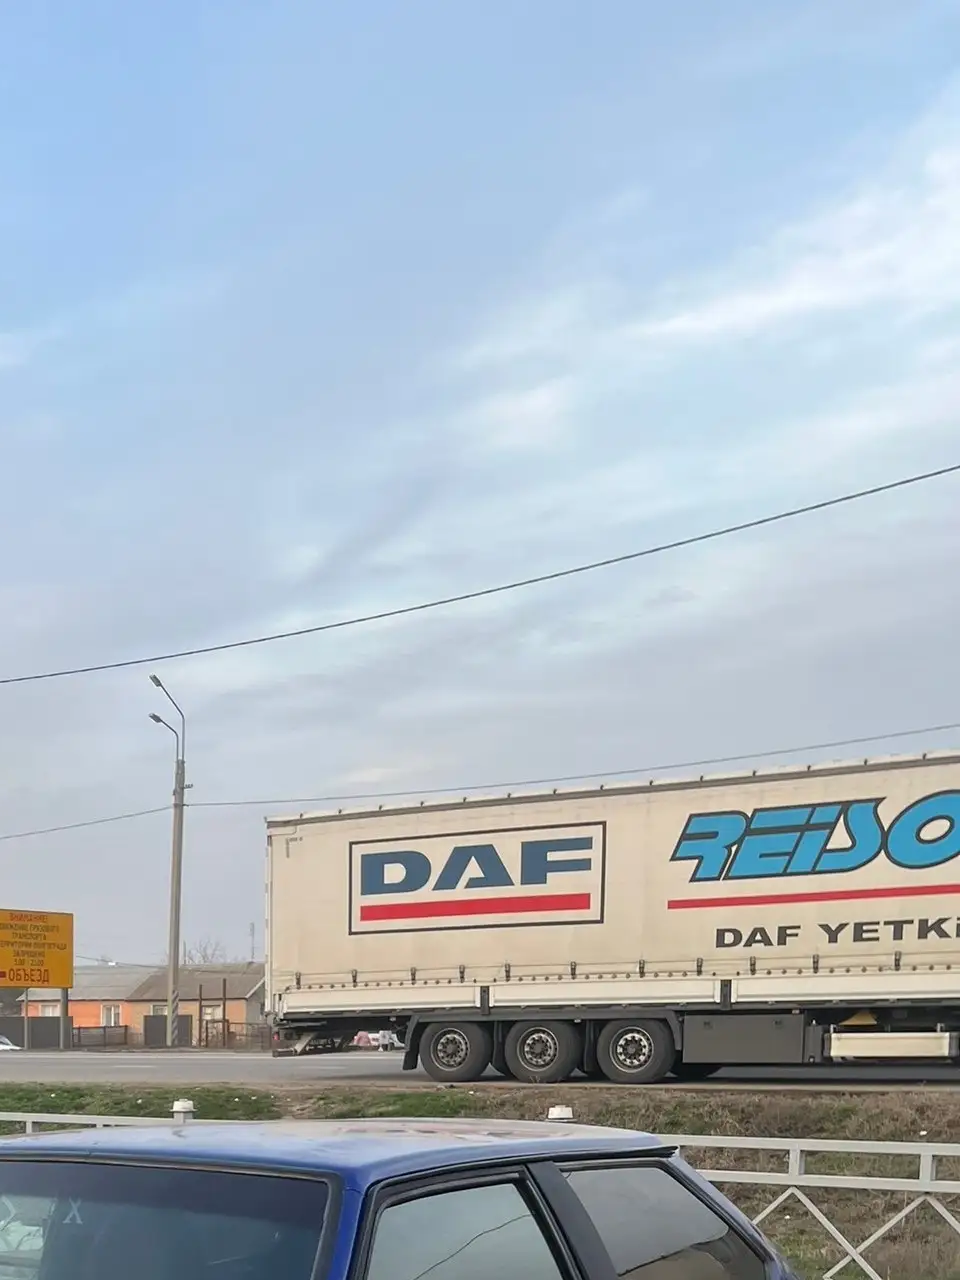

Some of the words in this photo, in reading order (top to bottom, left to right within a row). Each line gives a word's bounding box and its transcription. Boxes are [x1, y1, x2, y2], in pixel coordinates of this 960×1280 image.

[361, 837, 593, 896] DAF
[716, 925, 801, 948] DAF
[8, 968, 50, 984] ОБЪЕЗД
